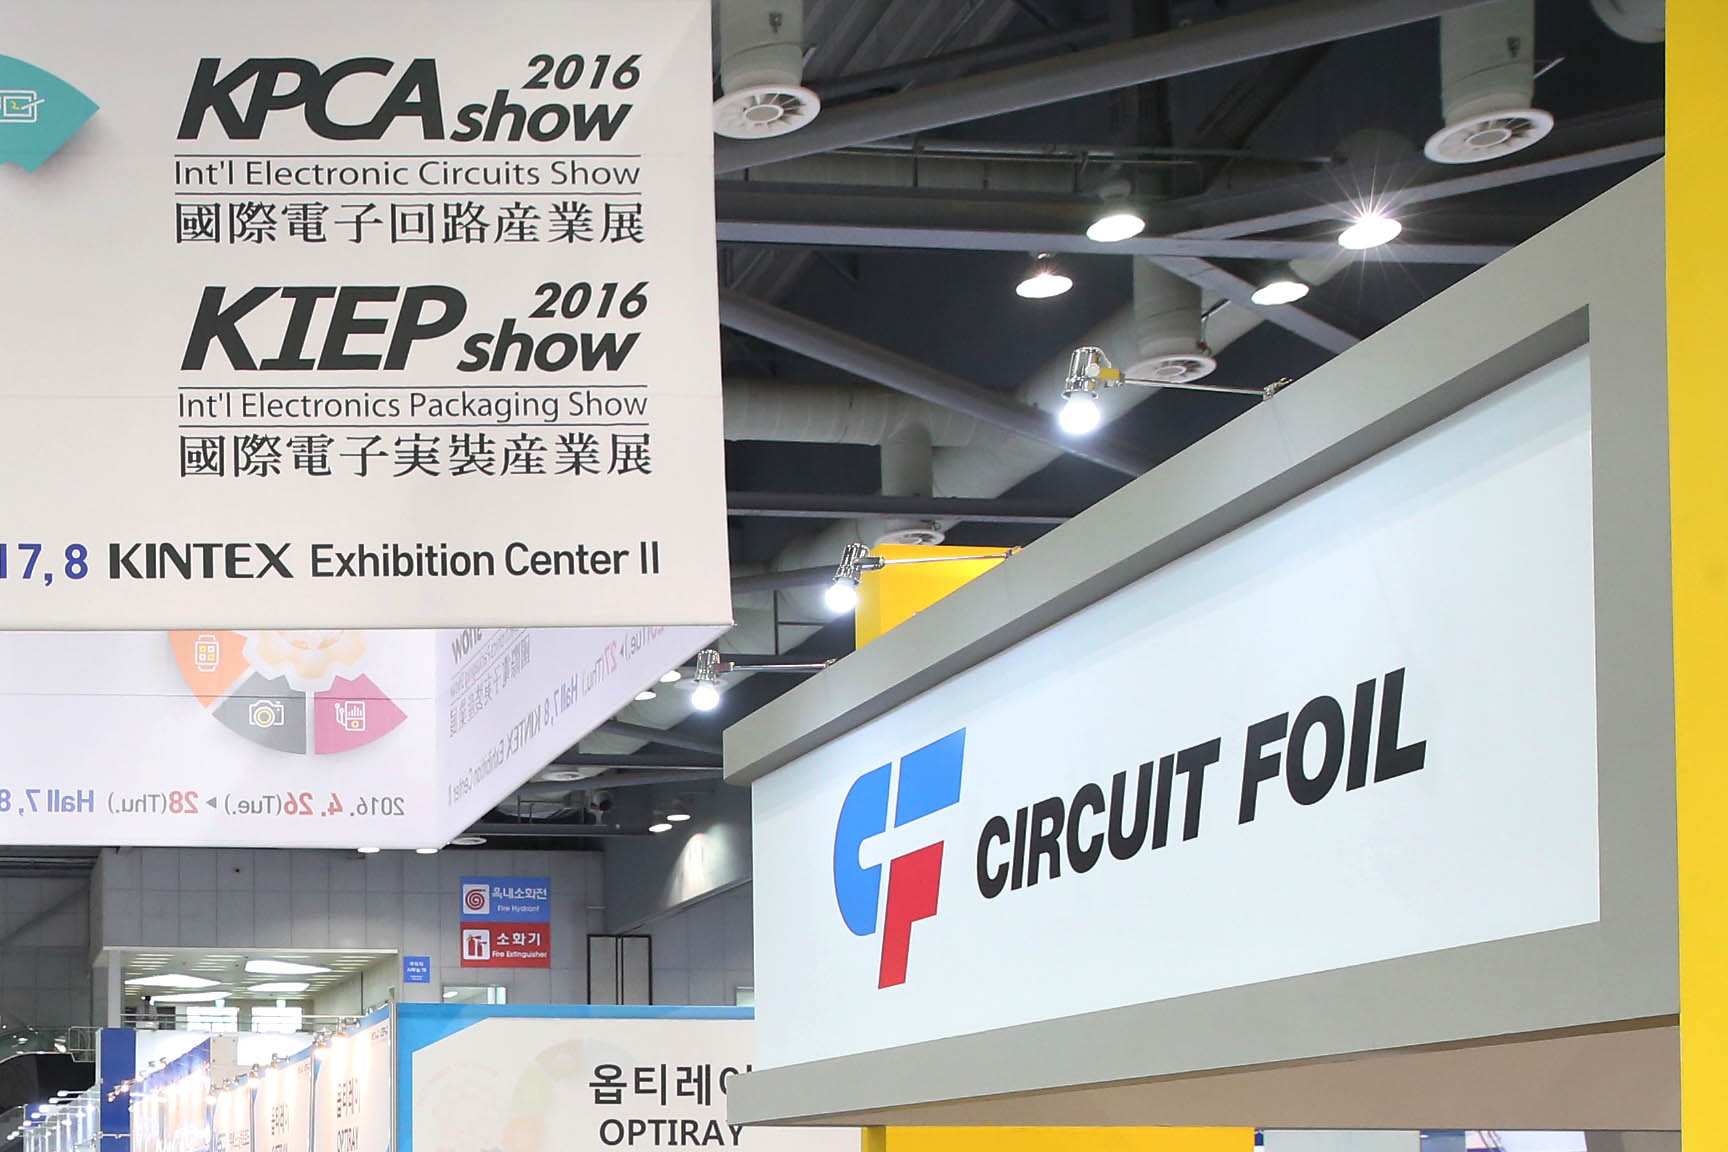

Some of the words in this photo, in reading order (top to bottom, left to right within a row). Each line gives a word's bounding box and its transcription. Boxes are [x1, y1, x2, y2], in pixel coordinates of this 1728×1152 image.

[523, 54, 642, 89] 2016
[176, 57, 445, 141] KPCA
[450, 89, 633, 142] show
[174, 160, 235, 186] Int'l
[246, 160, 409, 186] Electronic
[419, 160, 540, 186] Circuits
[551, 160, 641, 186] Show
[175, 201, 645, 244] 國際電子回路産業展
[529, 281, 649, 319] 2016
[181, 286, 467, 371] KIEP
[457, 318, 641, 372] show
[178, 392, 233, 418] Int'l
[242, 392, 400, 418] Electronics
[410, 391, 559, 424] Packaging
[568, 391, 647, 416] Show
[18, 543, 53, 586] 7,
[64, 543, 88, 579] 8
[109, 543, 293, 580] KINTEX
[312, 542, 495, 578] Exhibition
[504, 542, 630, 576] Center
[640, 541, 660, 575] II
[977, 737, 1221, 899] CIRCUIT
[1239, 667, 1427, 825] FOIL
[496, 932, 541, 946] 소화기
[599, 1119, 745, 1147] OPTIRAY
